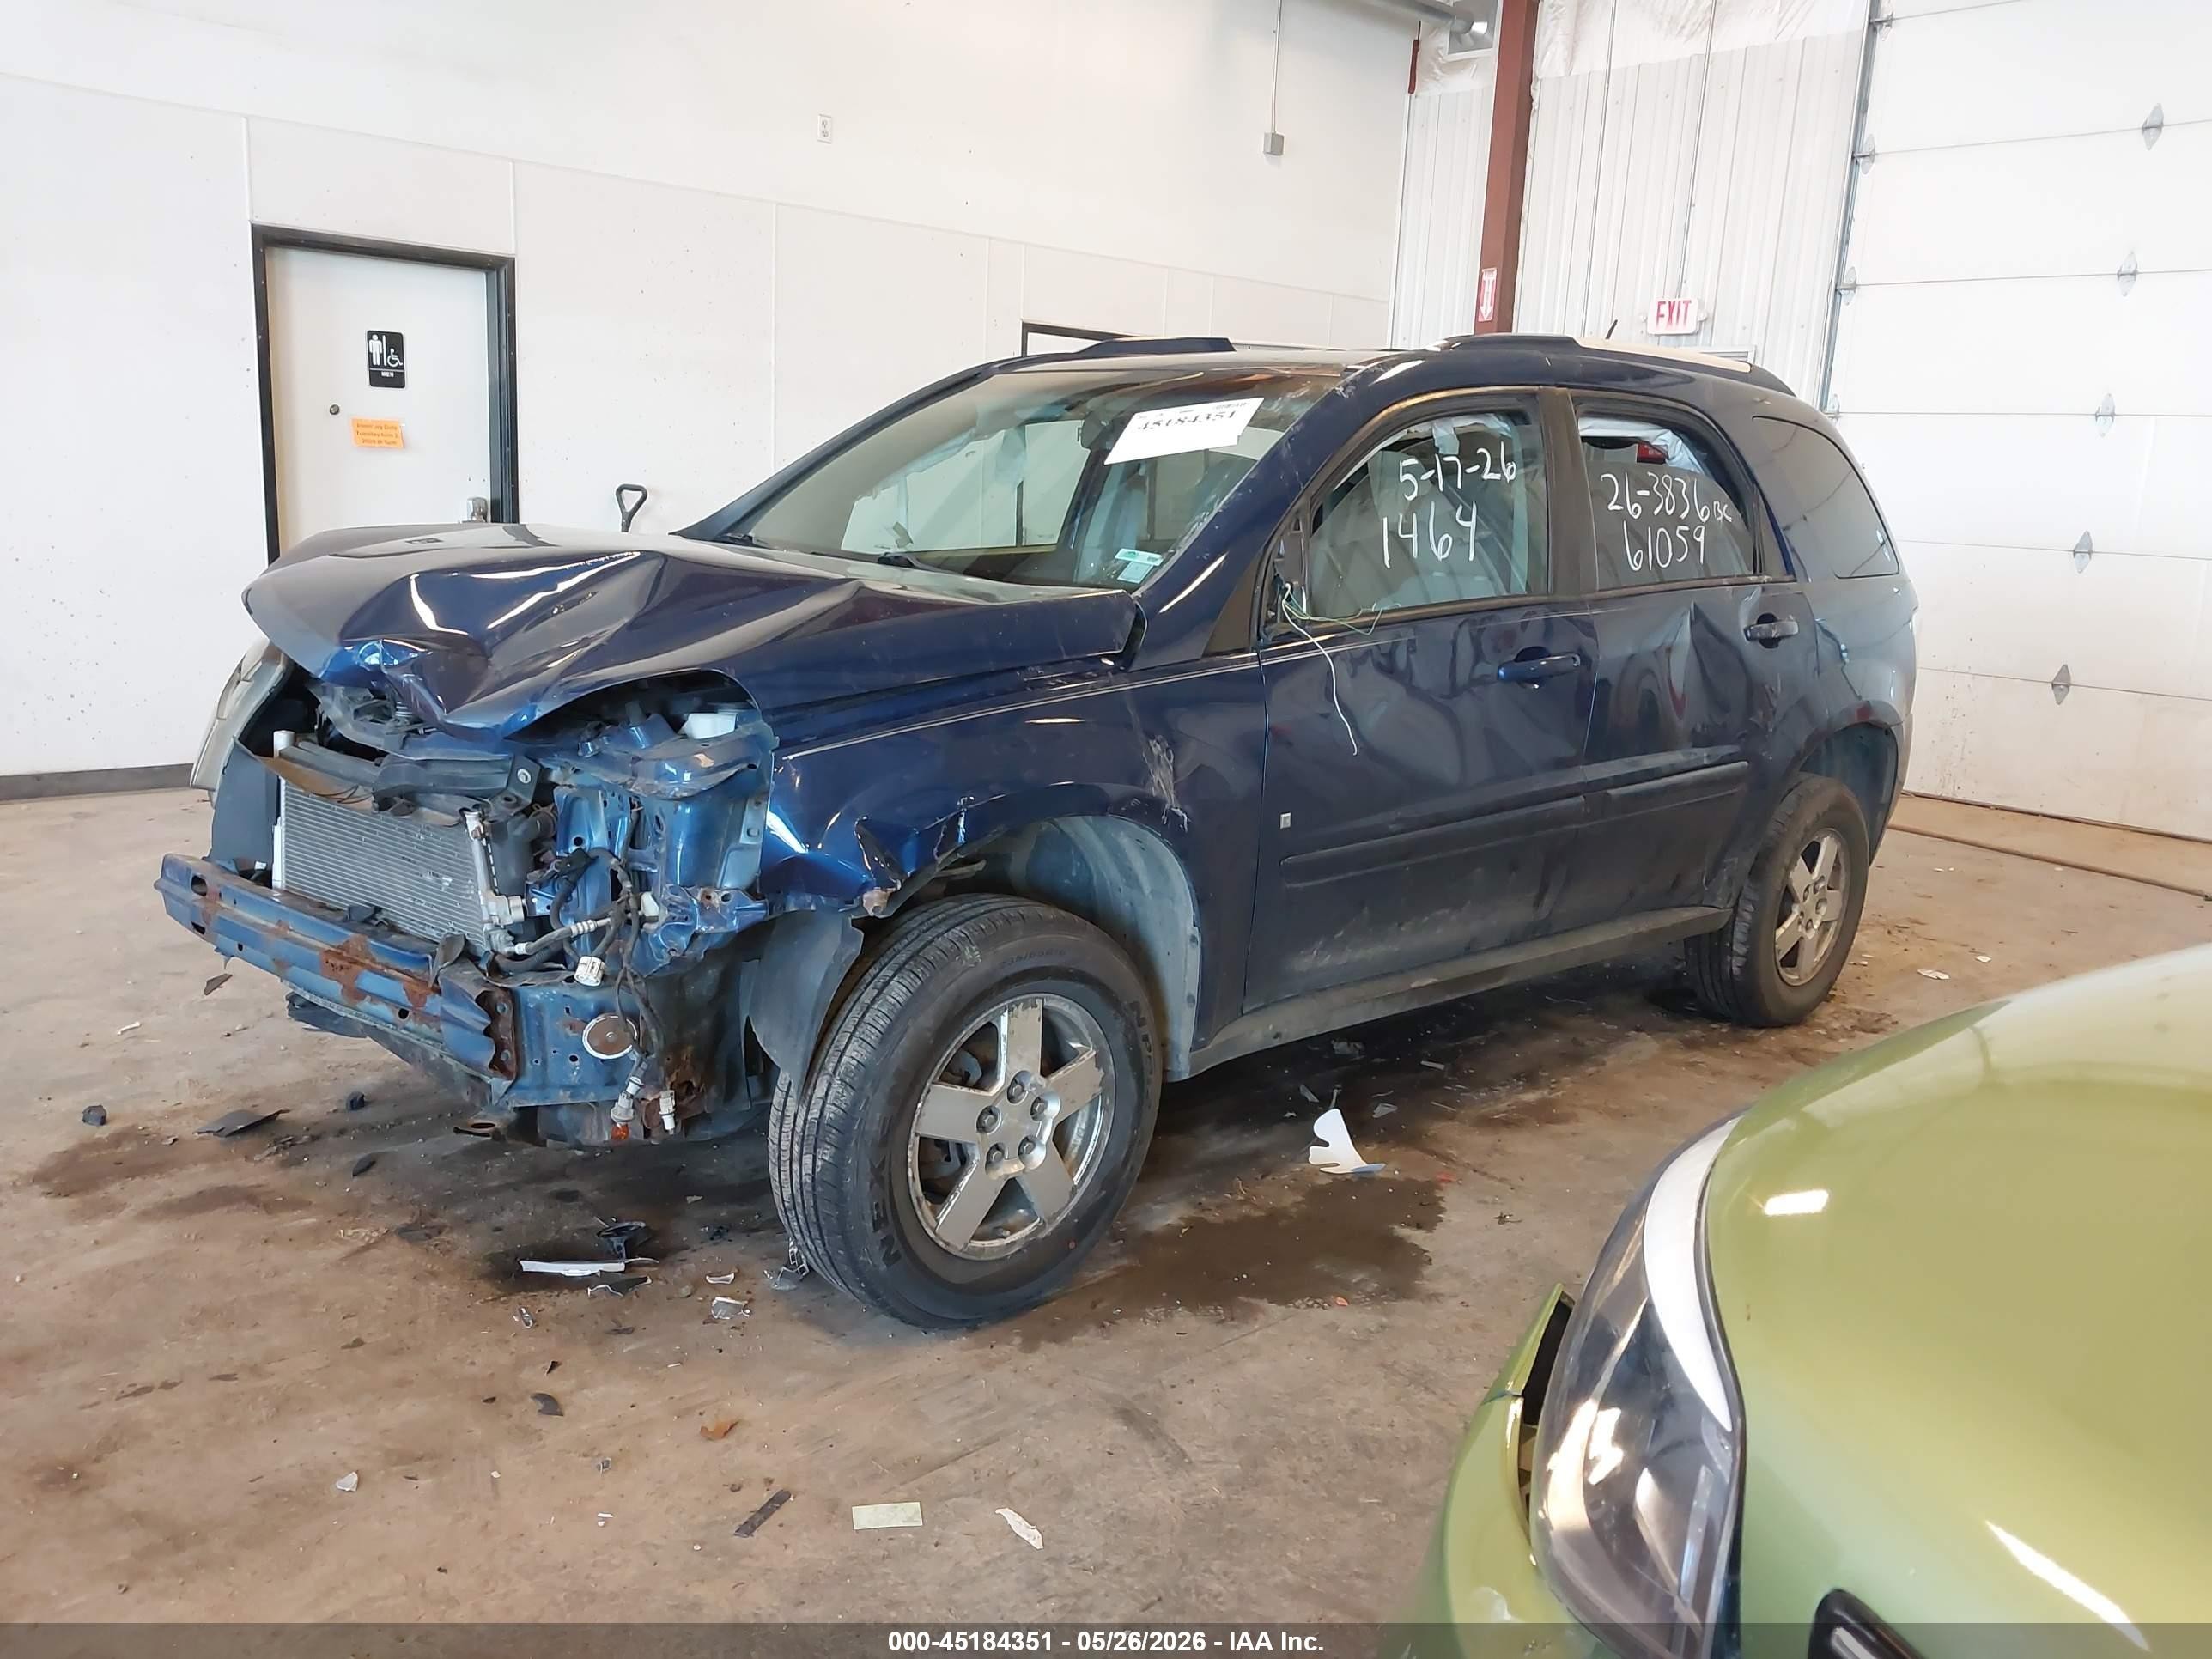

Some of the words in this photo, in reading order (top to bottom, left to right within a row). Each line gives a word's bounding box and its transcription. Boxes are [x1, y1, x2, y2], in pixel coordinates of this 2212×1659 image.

[1656, 300, 1692, 325] EXIT
[1399, 441, 1517, 501] 5-17-26
[1382, 501, 1478, 568] 1464
[1623, 520, 1705, 571] 61059
